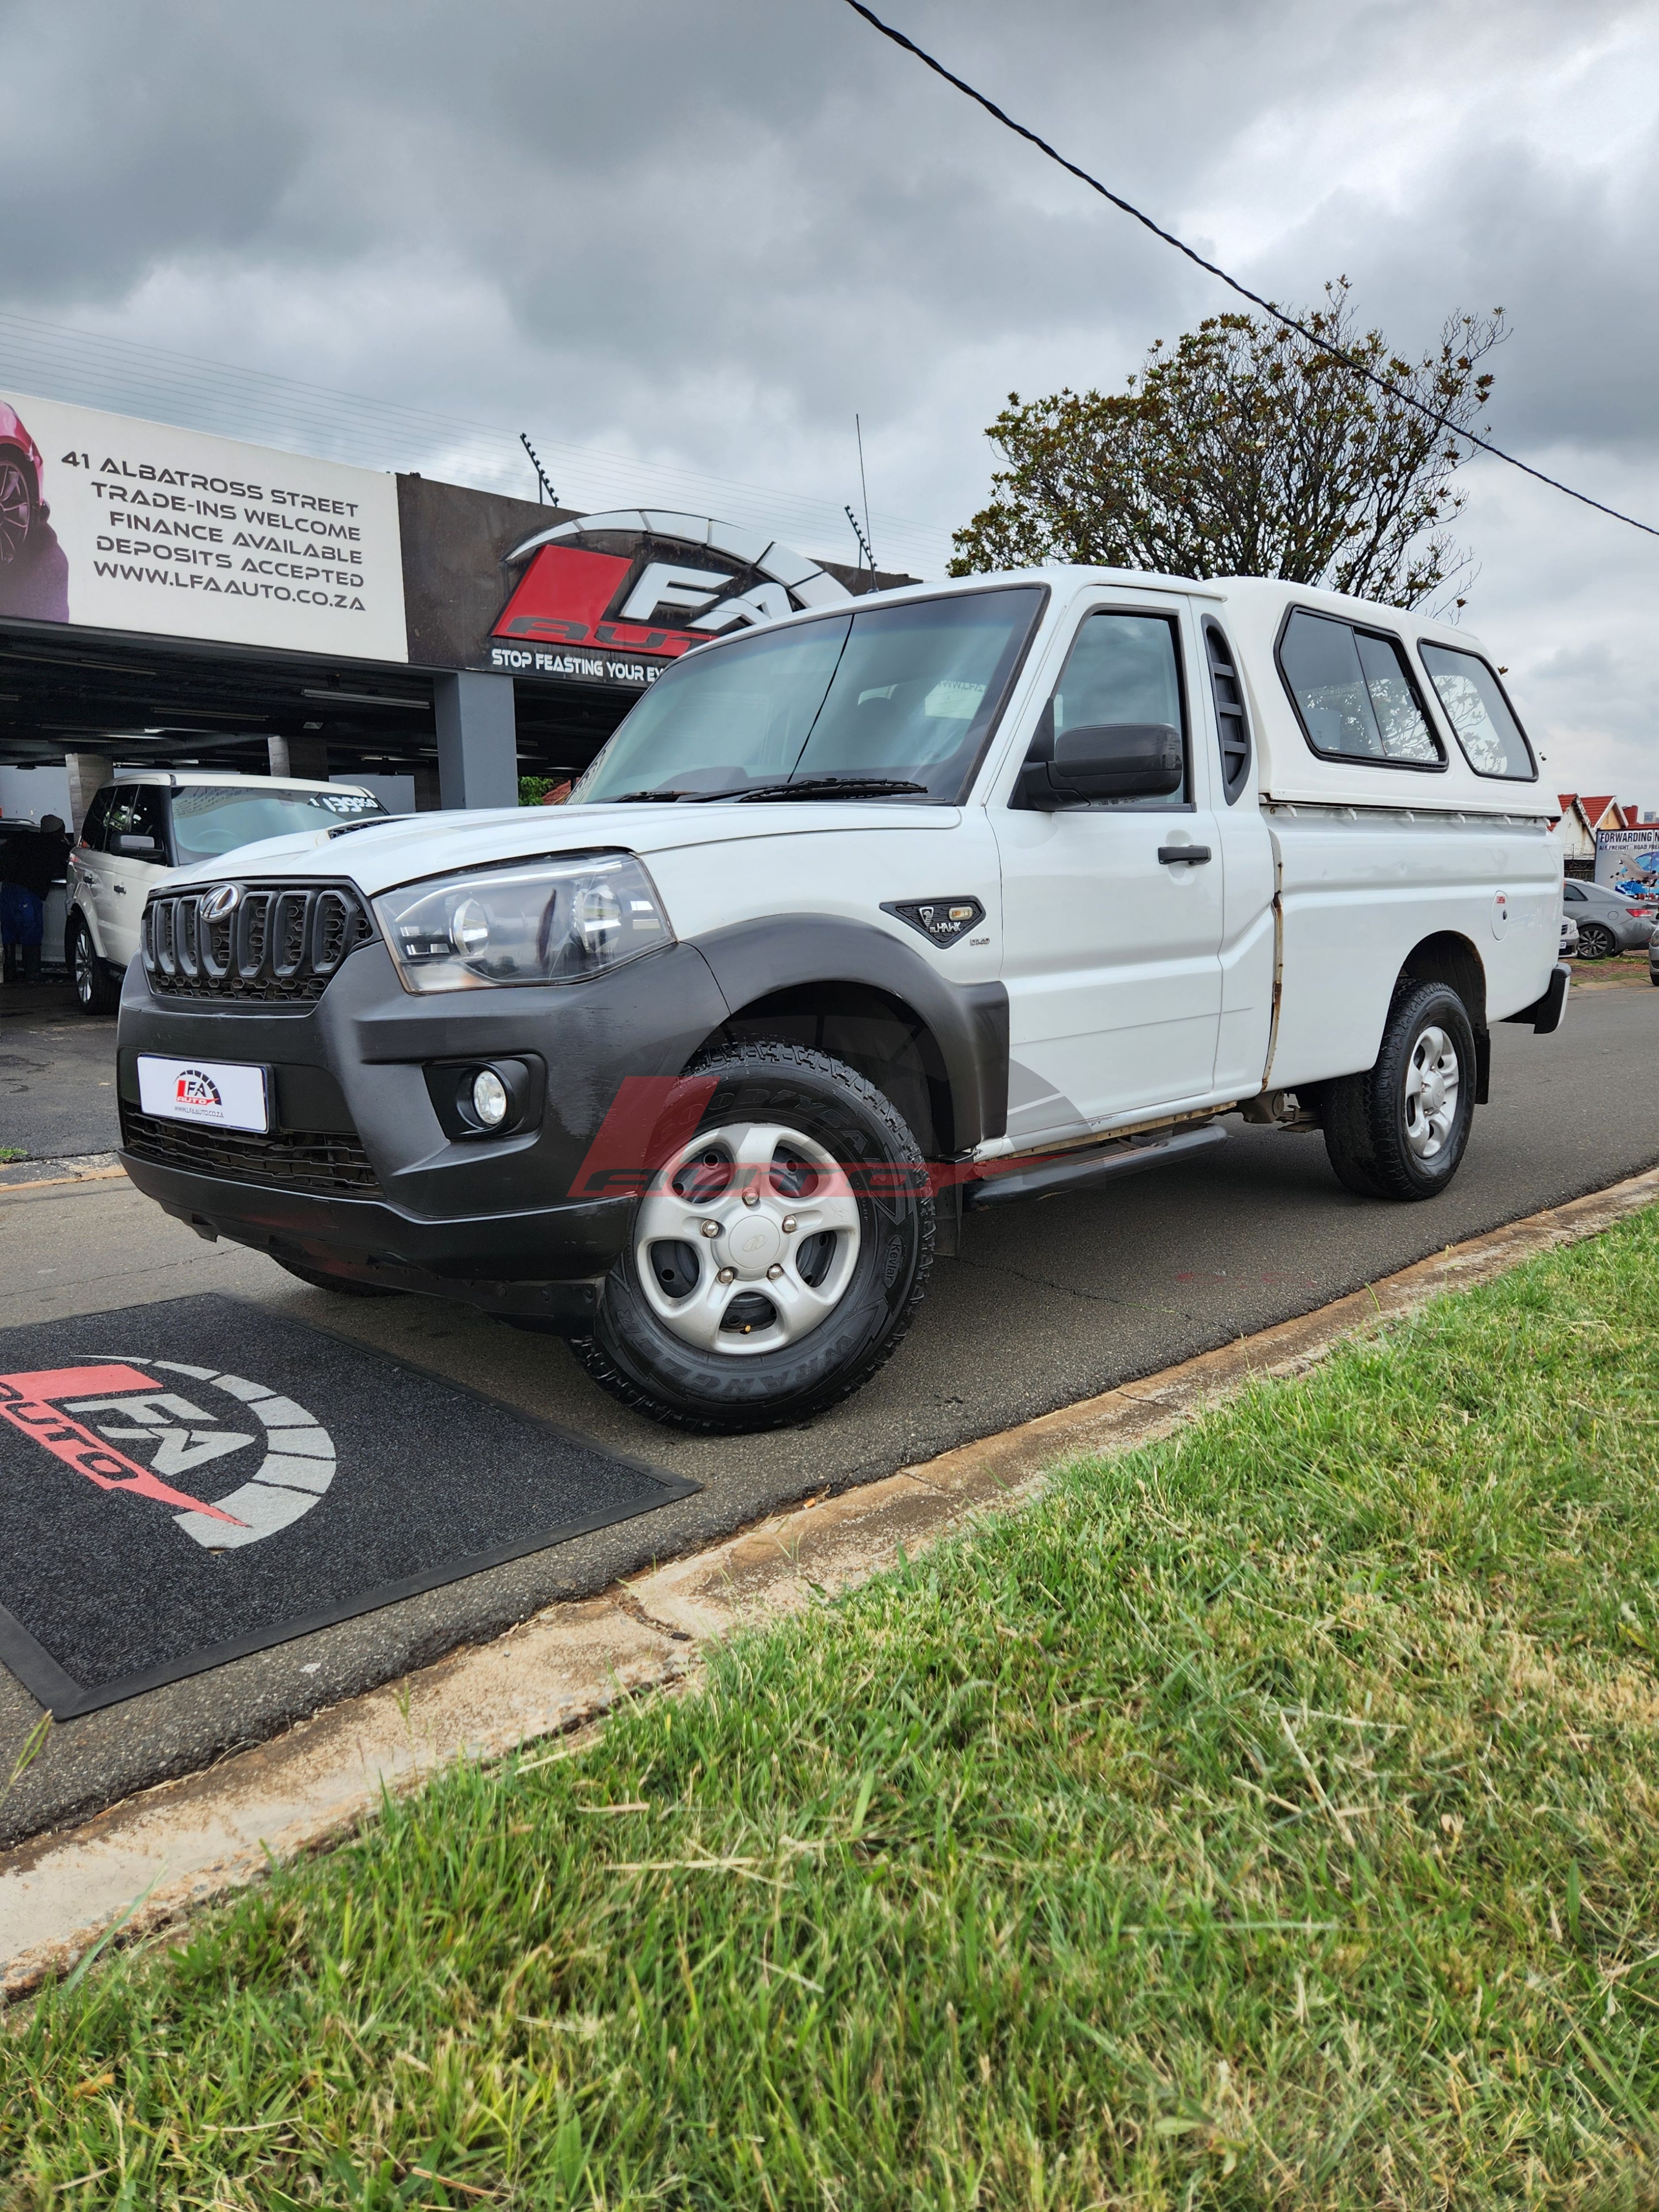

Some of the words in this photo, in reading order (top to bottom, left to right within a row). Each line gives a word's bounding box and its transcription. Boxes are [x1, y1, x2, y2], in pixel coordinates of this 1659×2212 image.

[61, 451, 90, 469] 41
[100, 458, 263, 500] ALBATROSS
[270, 489, 359, 518] STREET
[90, 481, 237, 520] TRADE-INS
[244, 508, 361, 541] WELCOME
[96, 535, 232, 569] DEPOSITS
[240, 558, 364, 587] ACCEPTED
[110, 511, 223, 543] FINANCE
[232, 532, 362, 565] AVAILABLE
[93, 561, 366, 611] WWW.LFAAUTO.CO.ZA
[491, 648, 532, 668] STOP
[535, 653, 604, 677] FEASTING
[606, 661, 644, 681] YOUR
[1600, 832, 1652, 843] FORWARDING
[177, 1096, 207, 1105] AUTO
[885, 1243, 902, 1280] Kevlar
